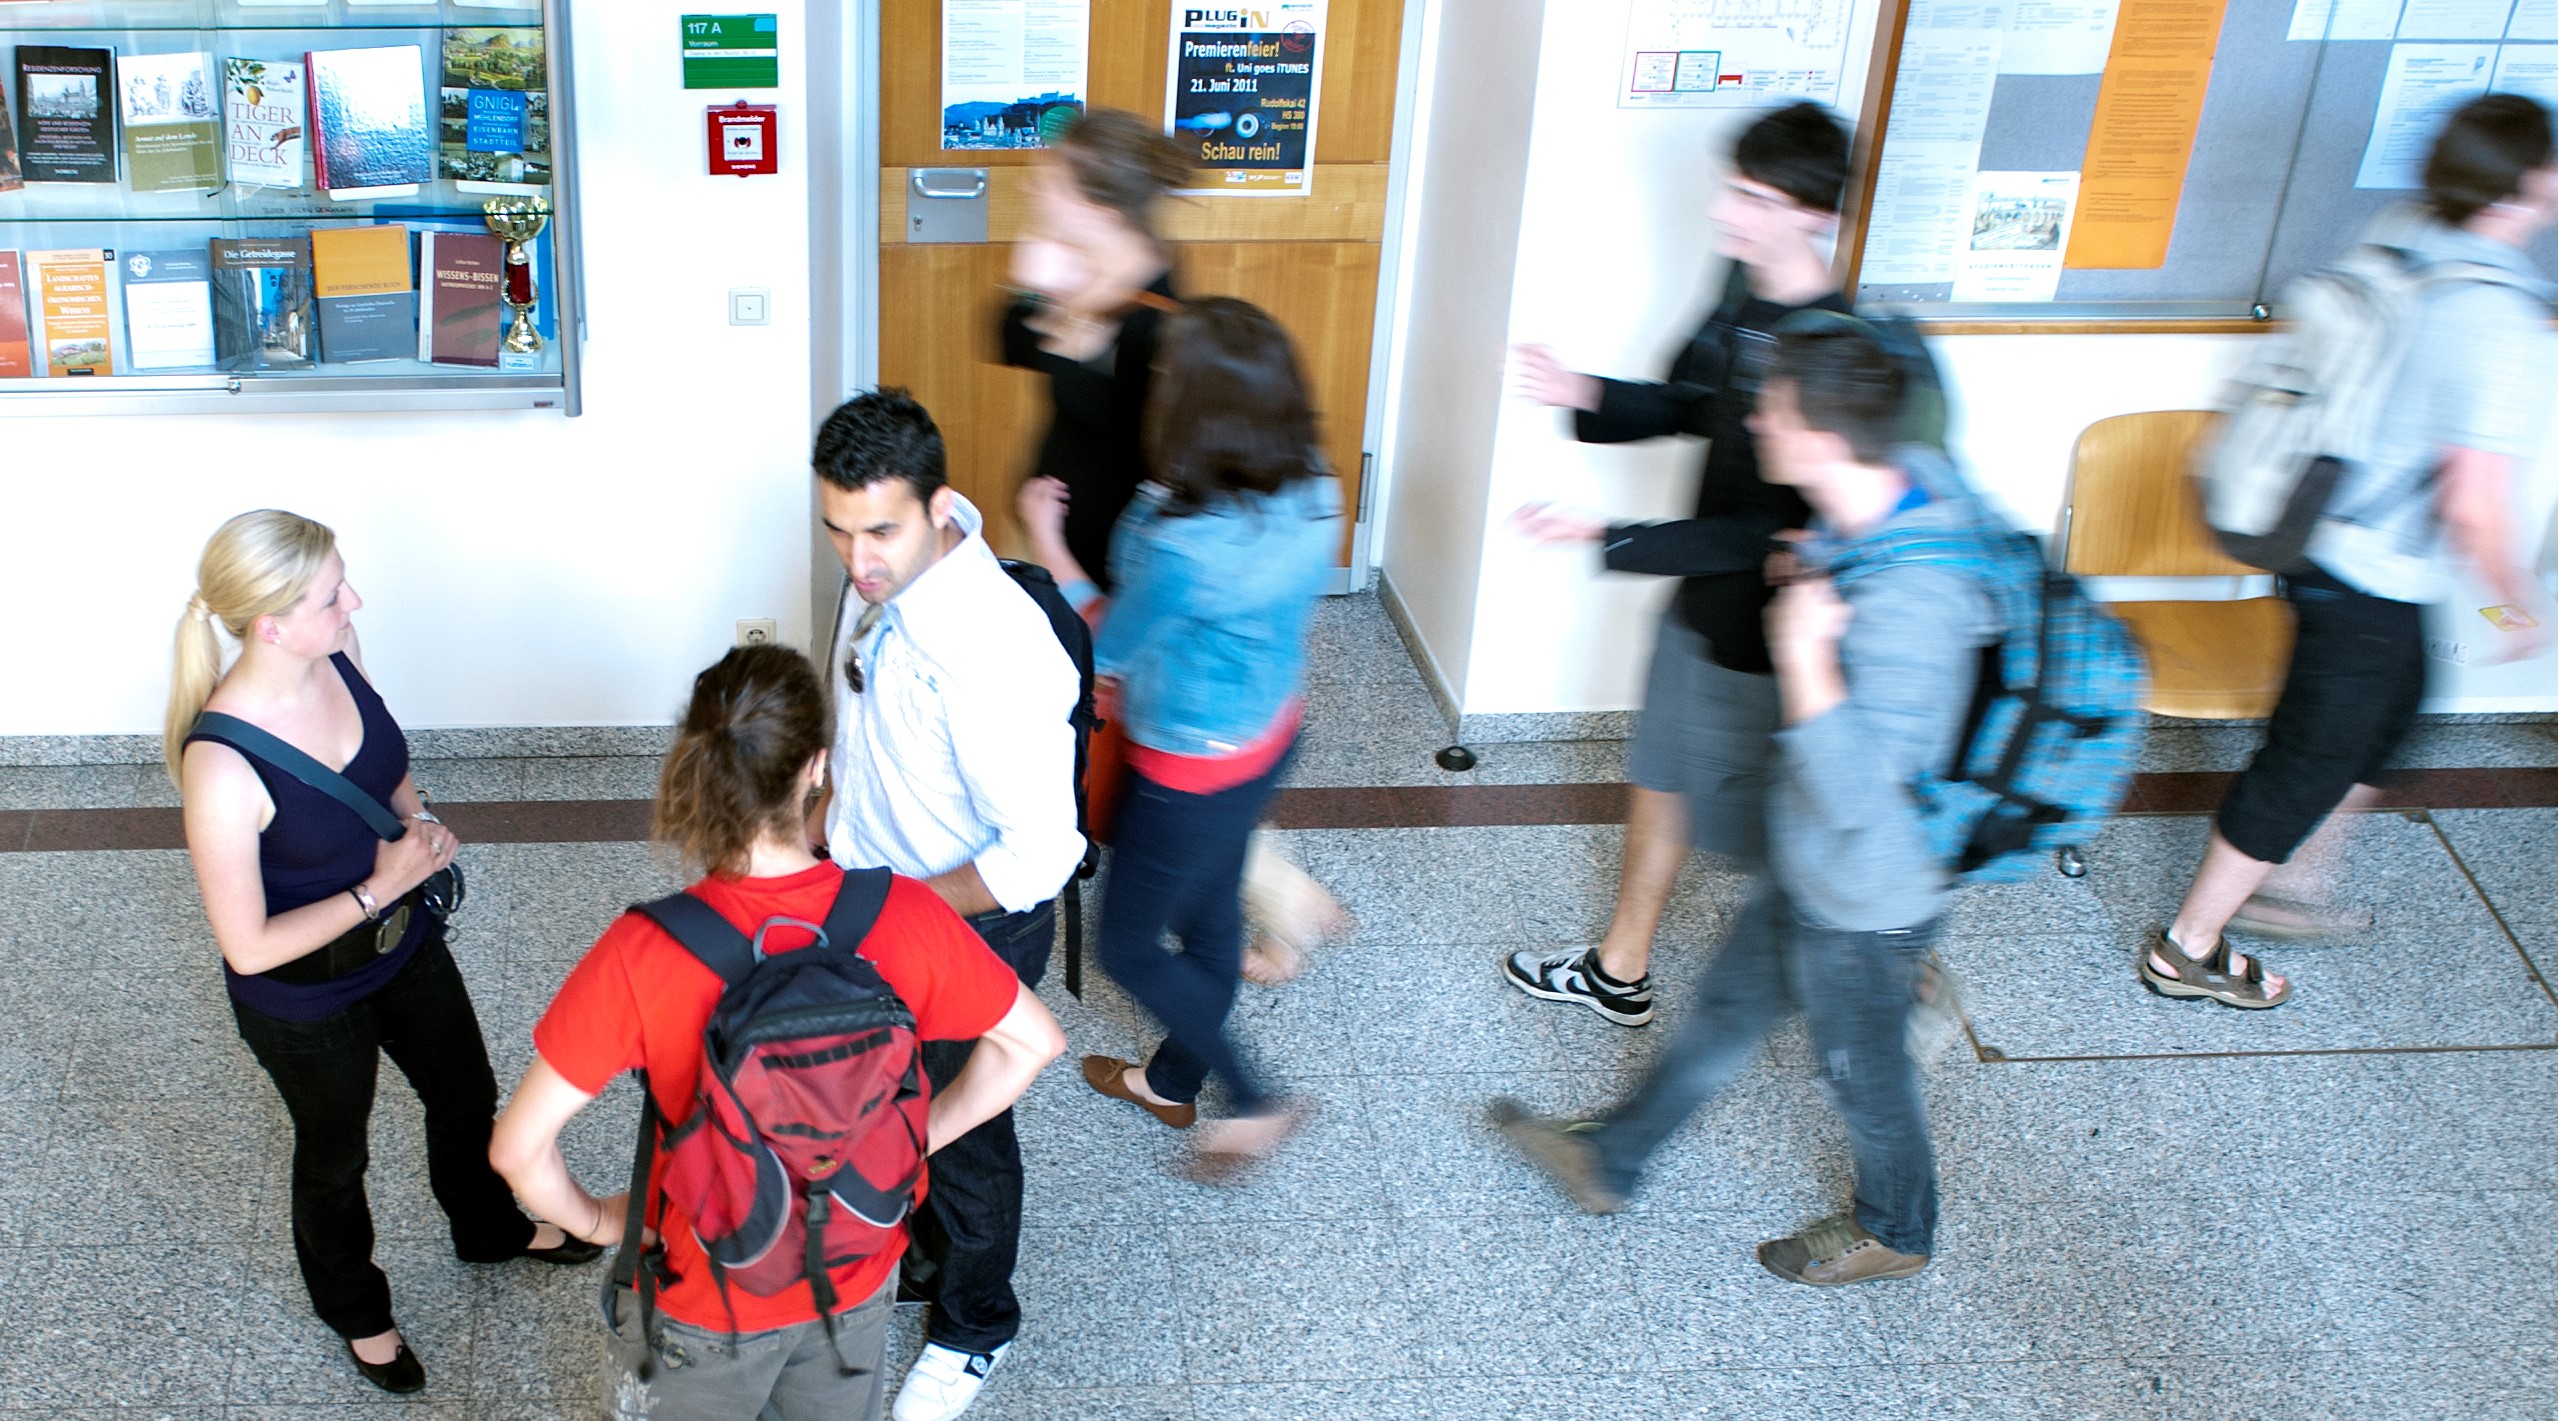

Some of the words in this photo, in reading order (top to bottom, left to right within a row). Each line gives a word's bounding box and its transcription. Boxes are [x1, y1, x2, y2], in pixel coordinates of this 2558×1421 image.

[687, 22, 708, 34] 117
[711, 22, 722, 34] A
[688, 40, 719, 48] Vorraum
[1237, 63, 1253, 74] Uni
[1254, 65, 1275, 75] goes
[1276, 63, 1310, 74] iTUNES
[1190, 78, 1207, 93] 21.
[1208, 78, 1231, 93] Juni
[1232, 78, 1258, 93] 2011
[1297, 98, 1307, 109] 42
[231, 103, 297, 125] TIGER
[718, 115, 766, 123] Brandmelder
[232, 124, 263, 141] AN
[473, 126, 519, 134] EISENBAHN
[473, 137, 519, 146] STADTTEIL
[232, 144, 288, 166] DECK
[1201, 141, 1246, 161] Schau
[1248, 142, 1281, 161] rein!
[223, 250, 239, 259] Die
[240, 248, 297, 260] Getreidegasse
[436, 269, 500, 283] WISSENS-BISSEN
